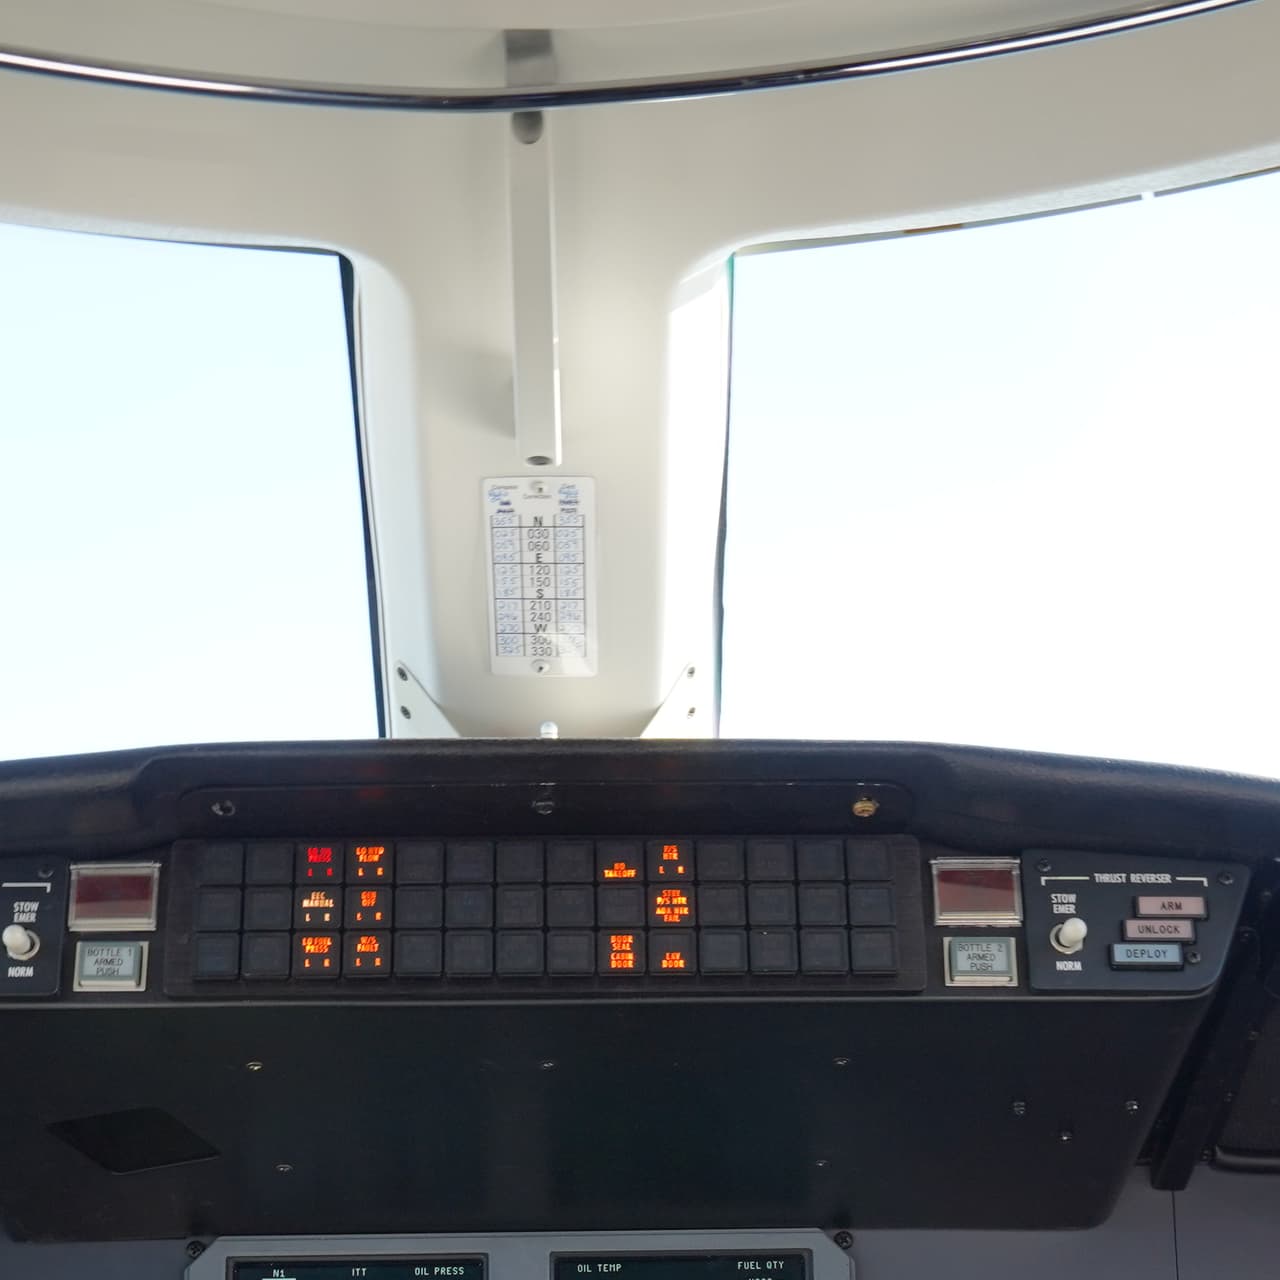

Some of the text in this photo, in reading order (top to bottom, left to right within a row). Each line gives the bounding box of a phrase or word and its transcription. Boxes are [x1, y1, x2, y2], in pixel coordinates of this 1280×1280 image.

[527, 529, 549, 539] 030
[528, 541, 550, 552] 060
[529, 565, 550, 575] 120
[529, 577, 551, 587] 150
[530, 601, 551, 611] 210
[530, 612, 552, 622] 240
[1094, 874, 1171, 883] THRUST REVERSER
[1051, 894, 1076, 904] STOW
[13, 902, 39, 912] STOW
[1053, 904, 1076, 914] EMER
[1160, 902, 1182, 911] ARM
[13, 913, 37, 923] EMER
[1137, 925, 1180, 935] UNLOCK
[1126, 949, 1168, 958] DEPLOY
[1056, 961, 1082, 971] NORM
[8, 967, 33, 977] NORM
[577, 1263, 622, 1273] OIL TEMP
[738, 1261, 784, 1270] FUEL QTY
[273, 1269, 285, 1277] N1
[352, 1268, 367, 1276] ITT
[414, 1267, 464, 1275] OIL PRESS
